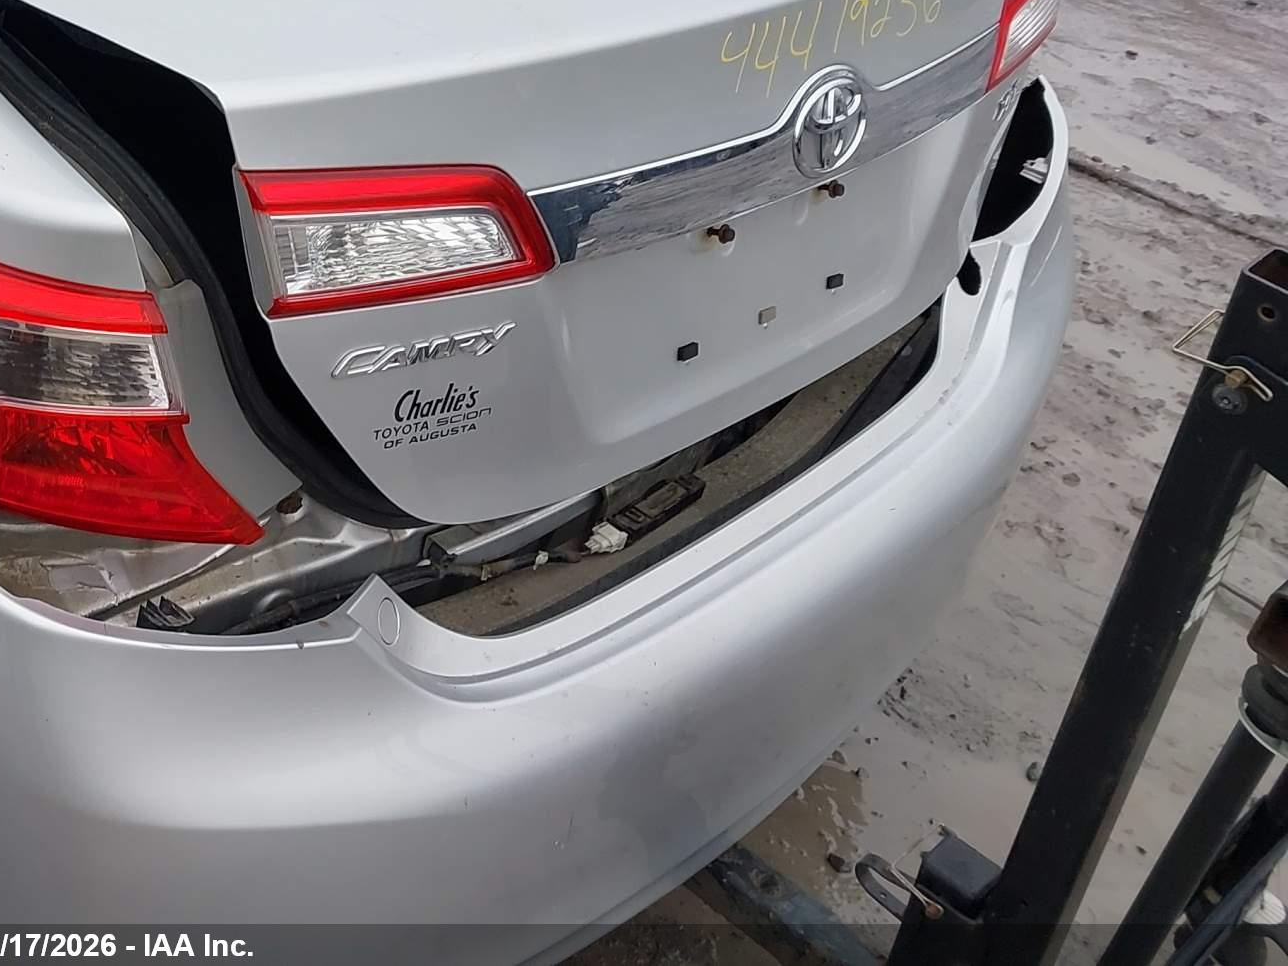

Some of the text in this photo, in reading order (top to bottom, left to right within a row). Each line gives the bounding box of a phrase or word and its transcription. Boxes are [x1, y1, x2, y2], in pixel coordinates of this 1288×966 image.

[331, 321, 516, 378] CAMRY
[394, 382, 479, 422] Charlie's
[373, 407, 492, 441] TOYOTA SCION
[383, 422, 477, 450] OF AUGUSTA
